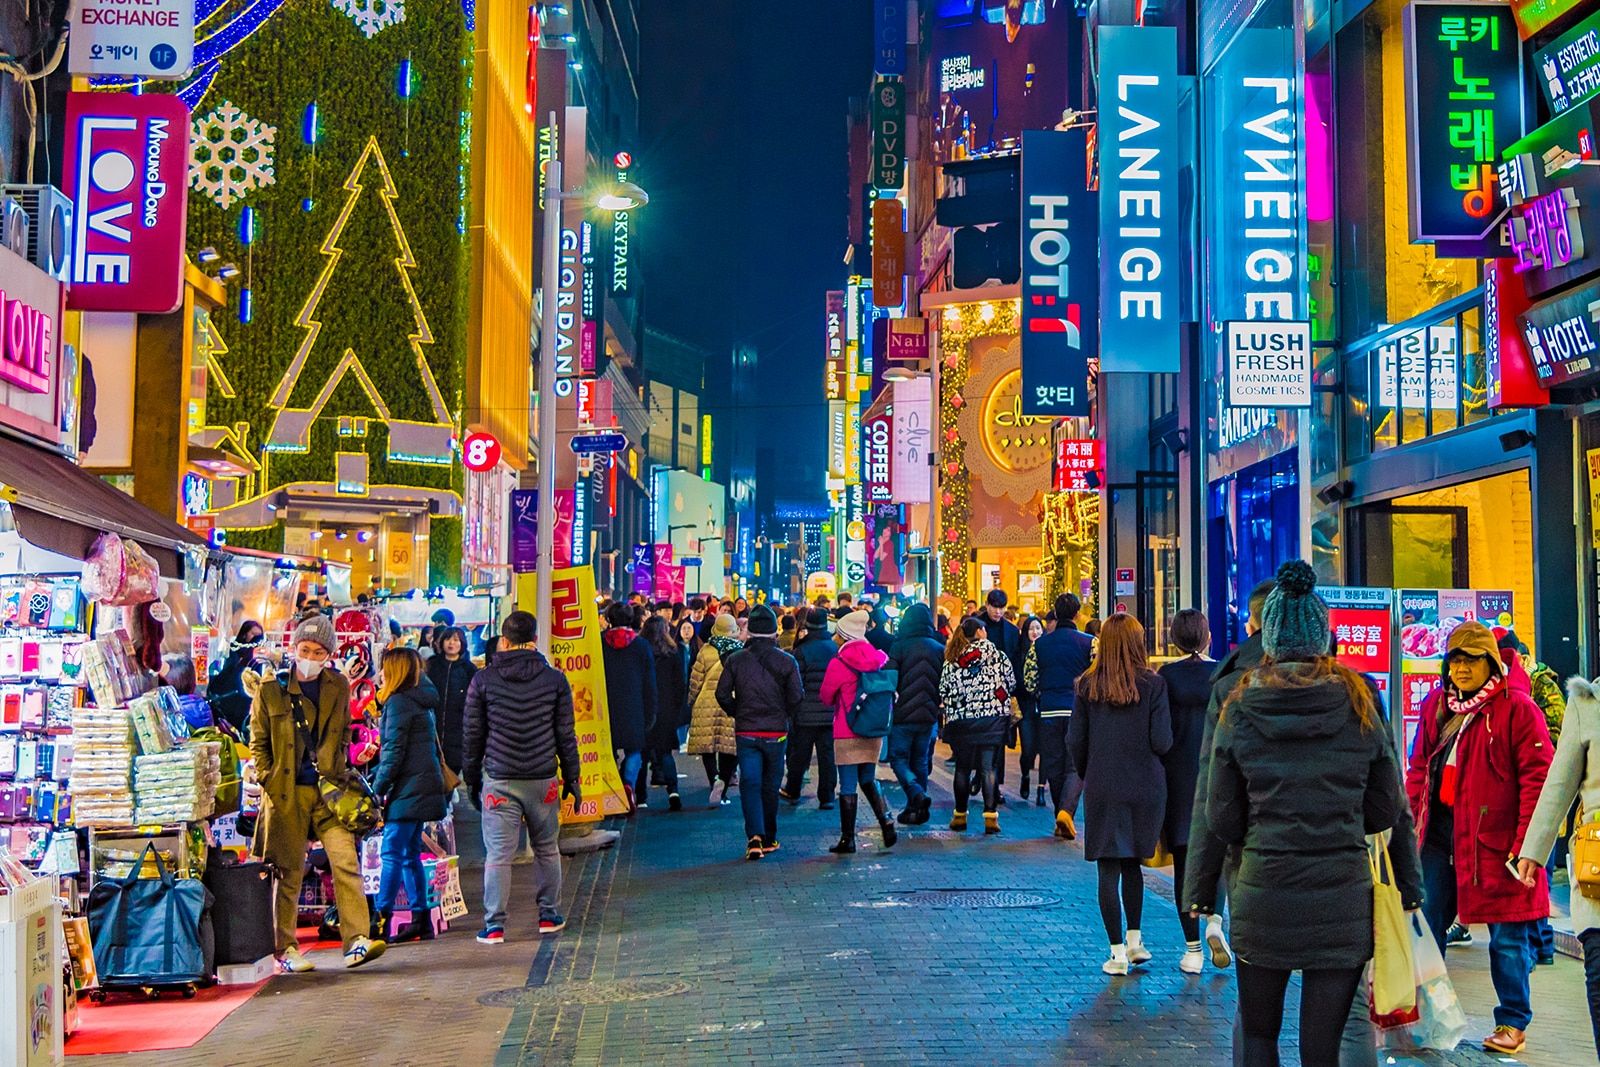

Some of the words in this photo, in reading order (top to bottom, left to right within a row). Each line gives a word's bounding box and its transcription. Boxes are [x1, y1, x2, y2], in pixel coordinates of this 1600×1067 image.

[82, 9, 179, 27] EXCHANGE
[1438, 16, 1499, 51] 루키
[89, 44, 138, 60] 오케이
[155, 50, 171, 62] 1F
[1558, 30, 1600, 73] ESTHETIC
[1567, 63, 1600, 100] エステサロ
[881, 120, 898, 185] DVD방
[1449, 57, 1499, 218] 노래방
[1579, 134, 1590, 154] B1
[1118, 74, 1162, 320] LANEIGE
[1497, 154, 1526, 207] 루키
[74, 117, 137, 283] LOVE
[1507, 188, 1572, 274] 노래방
[613, 211, 629, 292] SKYPARK
[555, 229, 578, 398] GIORDANO
[891, 334, 927, 347] Nail
[1235, 333, 1304, 351] LUSH
[1542, 315, 1597, 363] HOTEL
[1235, 355, 1304, 371] FRESH
[1236, 374, 1304, 383] HANDMADE
[1036, 385, 1075, 406] 핫티
[1236, 386, 1304, 396] COSMETICS
[467, 442, 487, 467] 8
[833, 411, 845, 468] innisfree
[872, 420, 889, 483] COFFEE
[1066, 442, 1093, 456] 高丽
[592, 452, 609, 502] Roem
[573, 511, 585, 565] FRIENDS
[392, 550, 409, 564] 50
[1336, 624, 1383, 643] 美容室
[1348, 645, 1365, 656] OK!
[584, 773, 600, 786] 4F
